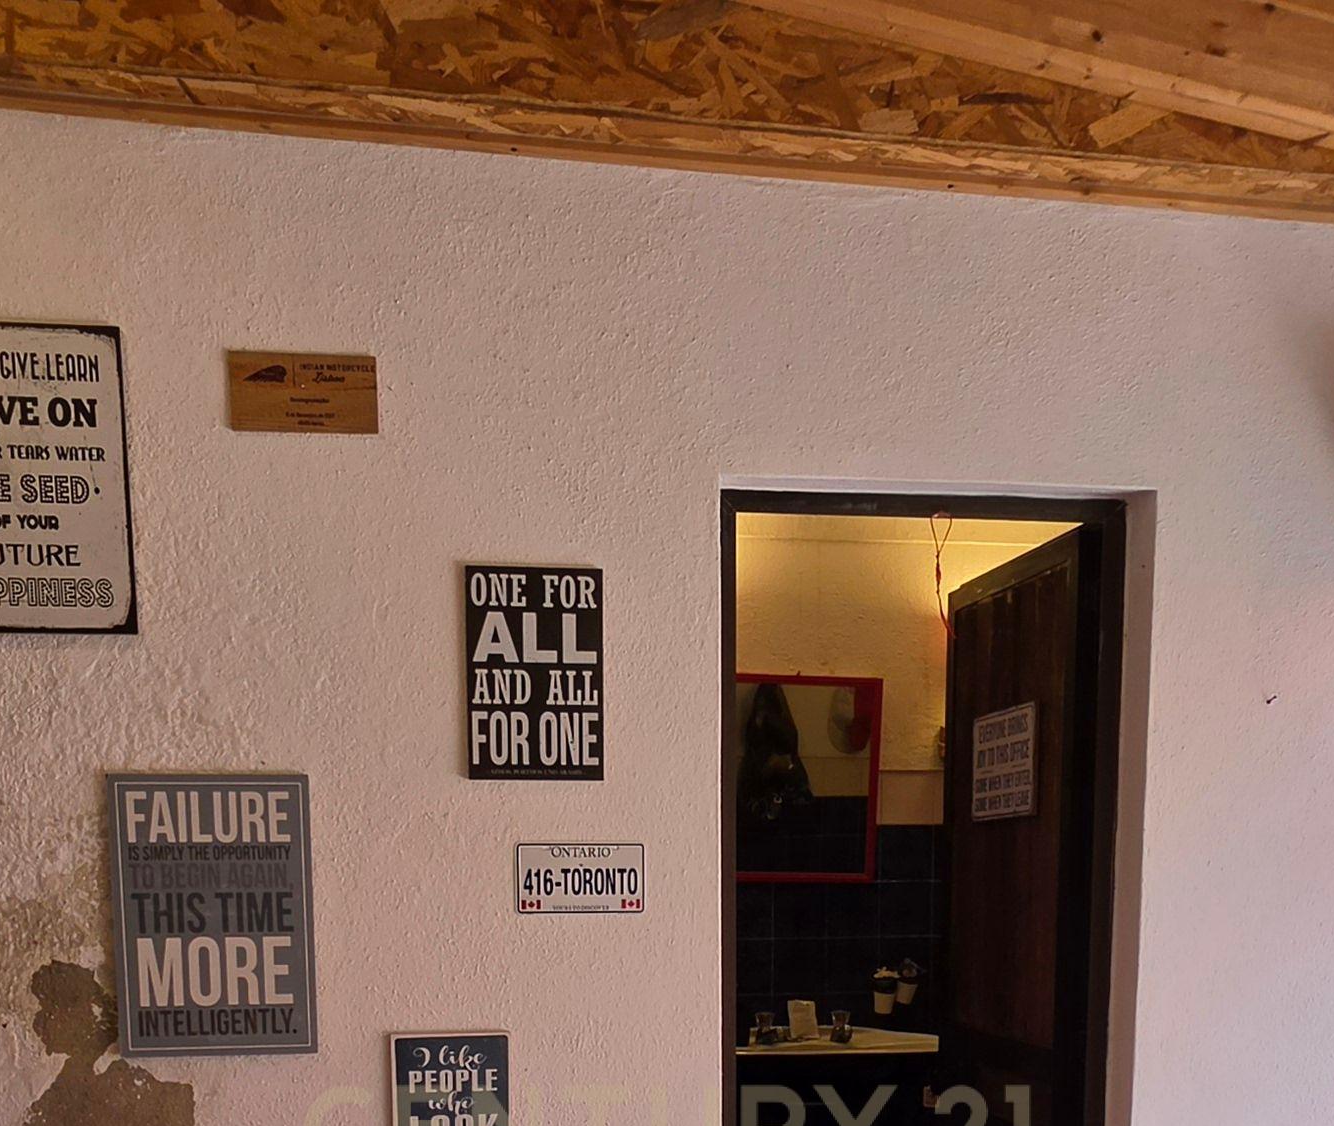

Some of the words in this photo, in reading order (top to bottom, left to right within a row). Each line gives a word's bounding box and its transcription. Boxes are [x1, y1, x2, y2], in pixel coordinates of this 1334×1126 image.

[48, 397, 97, 428] ON
[7, 444, 51, 461] TEARS
[55, 446, 105, 462] WATER
[21, 474, 90, 504] SEED
[17, 514, 59, 530] YOUR
[471, 572, 526, 607] ONE
[543, 575, 597, 608] FOR
[472, 611, 597, 664] ALL
[472, 668, 532, 705] AND
[546, 670, 598, 706] ALL
[471, 711, 529, 766] FOR
[539, 711, 599, 766] ONE
[125, 791, 291, 844] FAILURE
[128, 846, 139, 861] IS
[143, 846, 184, 861] SIMPLY
[187, 846, 209, 860] THE
[213, 845, 291, 860] OPPORTUNITY
[551, 846, 611, 858] ONTARIO
[129, 864, 154, 889] TO
[160, 863, 221, 889] BEGIN
[523, 868, 638, 896] 416-TORONTO
[131, 892, 206, 934] THIS
[214, 892, 294, 933] TIME
[136, 936, 294, 1008] MORE
[138, 1008, 297, 1037] INTELLIGENTLY.
[439, 1045, 487, 1072] like
[409, 1069, 498, 1094] PEOPLE
[429, 1090, 473, 1116] who
